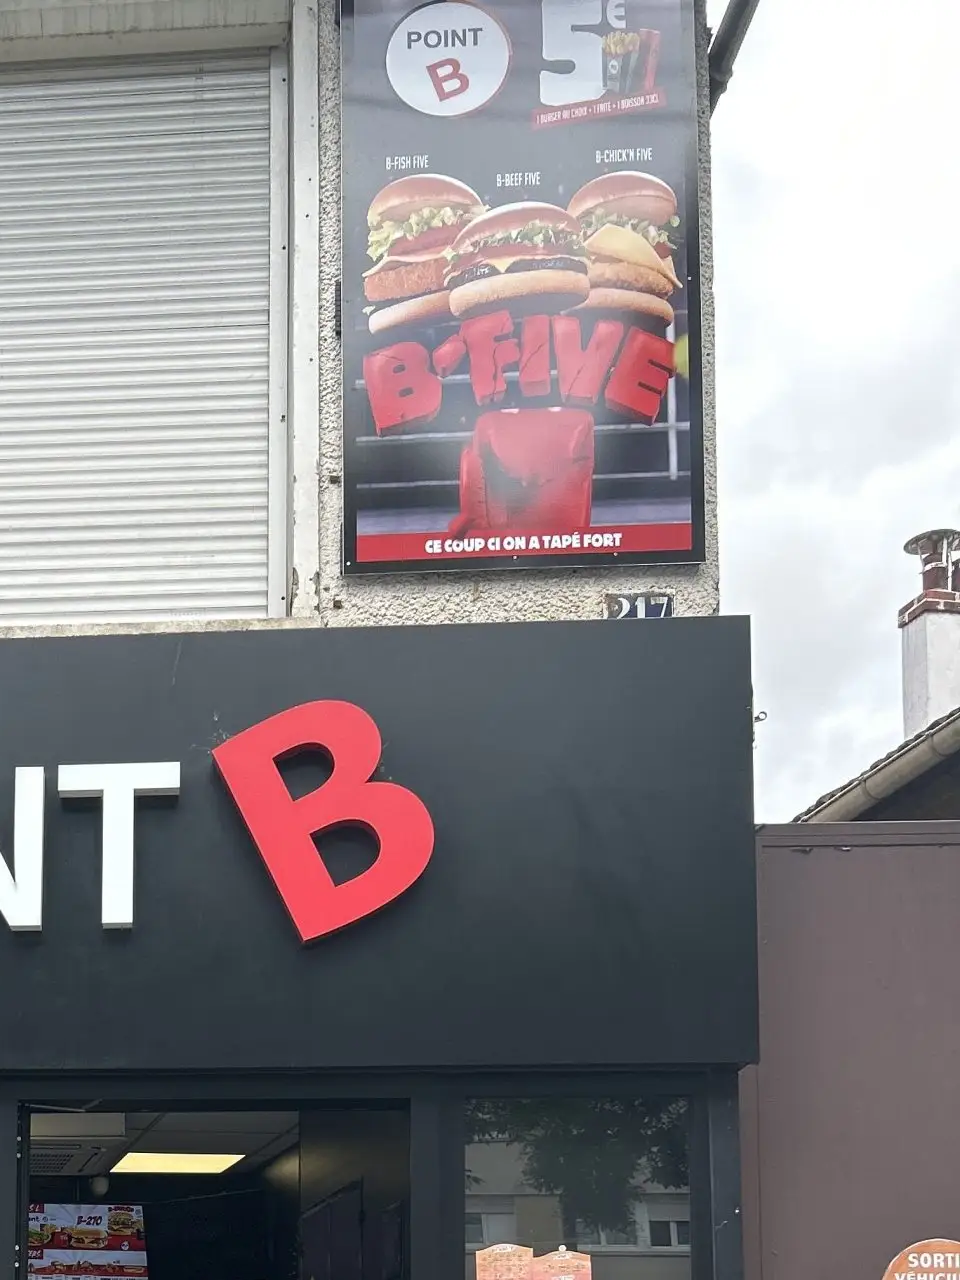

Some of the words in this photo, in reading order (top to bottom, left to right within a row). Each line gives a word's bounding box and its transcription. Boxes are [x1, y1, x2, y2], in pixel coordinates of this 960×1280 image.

[406, 28, 483, 49] POINT
[425, 57, 470, 103] B
[385, 156, 411, 170] B-FISH
[412, 154, 430, 169] FIVE
[595, 149, 635, 163] B-CHICK'N
[636, 147, 653, 161] FIVE
[496, 173, 523, 188] B-BEEF
[524, 171, 541, 186] FIVE
[424, 539, 442, 554] CE
[444, 538, 486, 553] COUP
[487, 537, 501, 551] CI
[502, 536, 526, 550] ON
[528, 536, 540, 550] A
[542, 532, 581, 549] TAPÉ
[583, 533, 623, 548] FORT
[611, 597, 669, 619] 217
[211, 700, 436, 944] B
